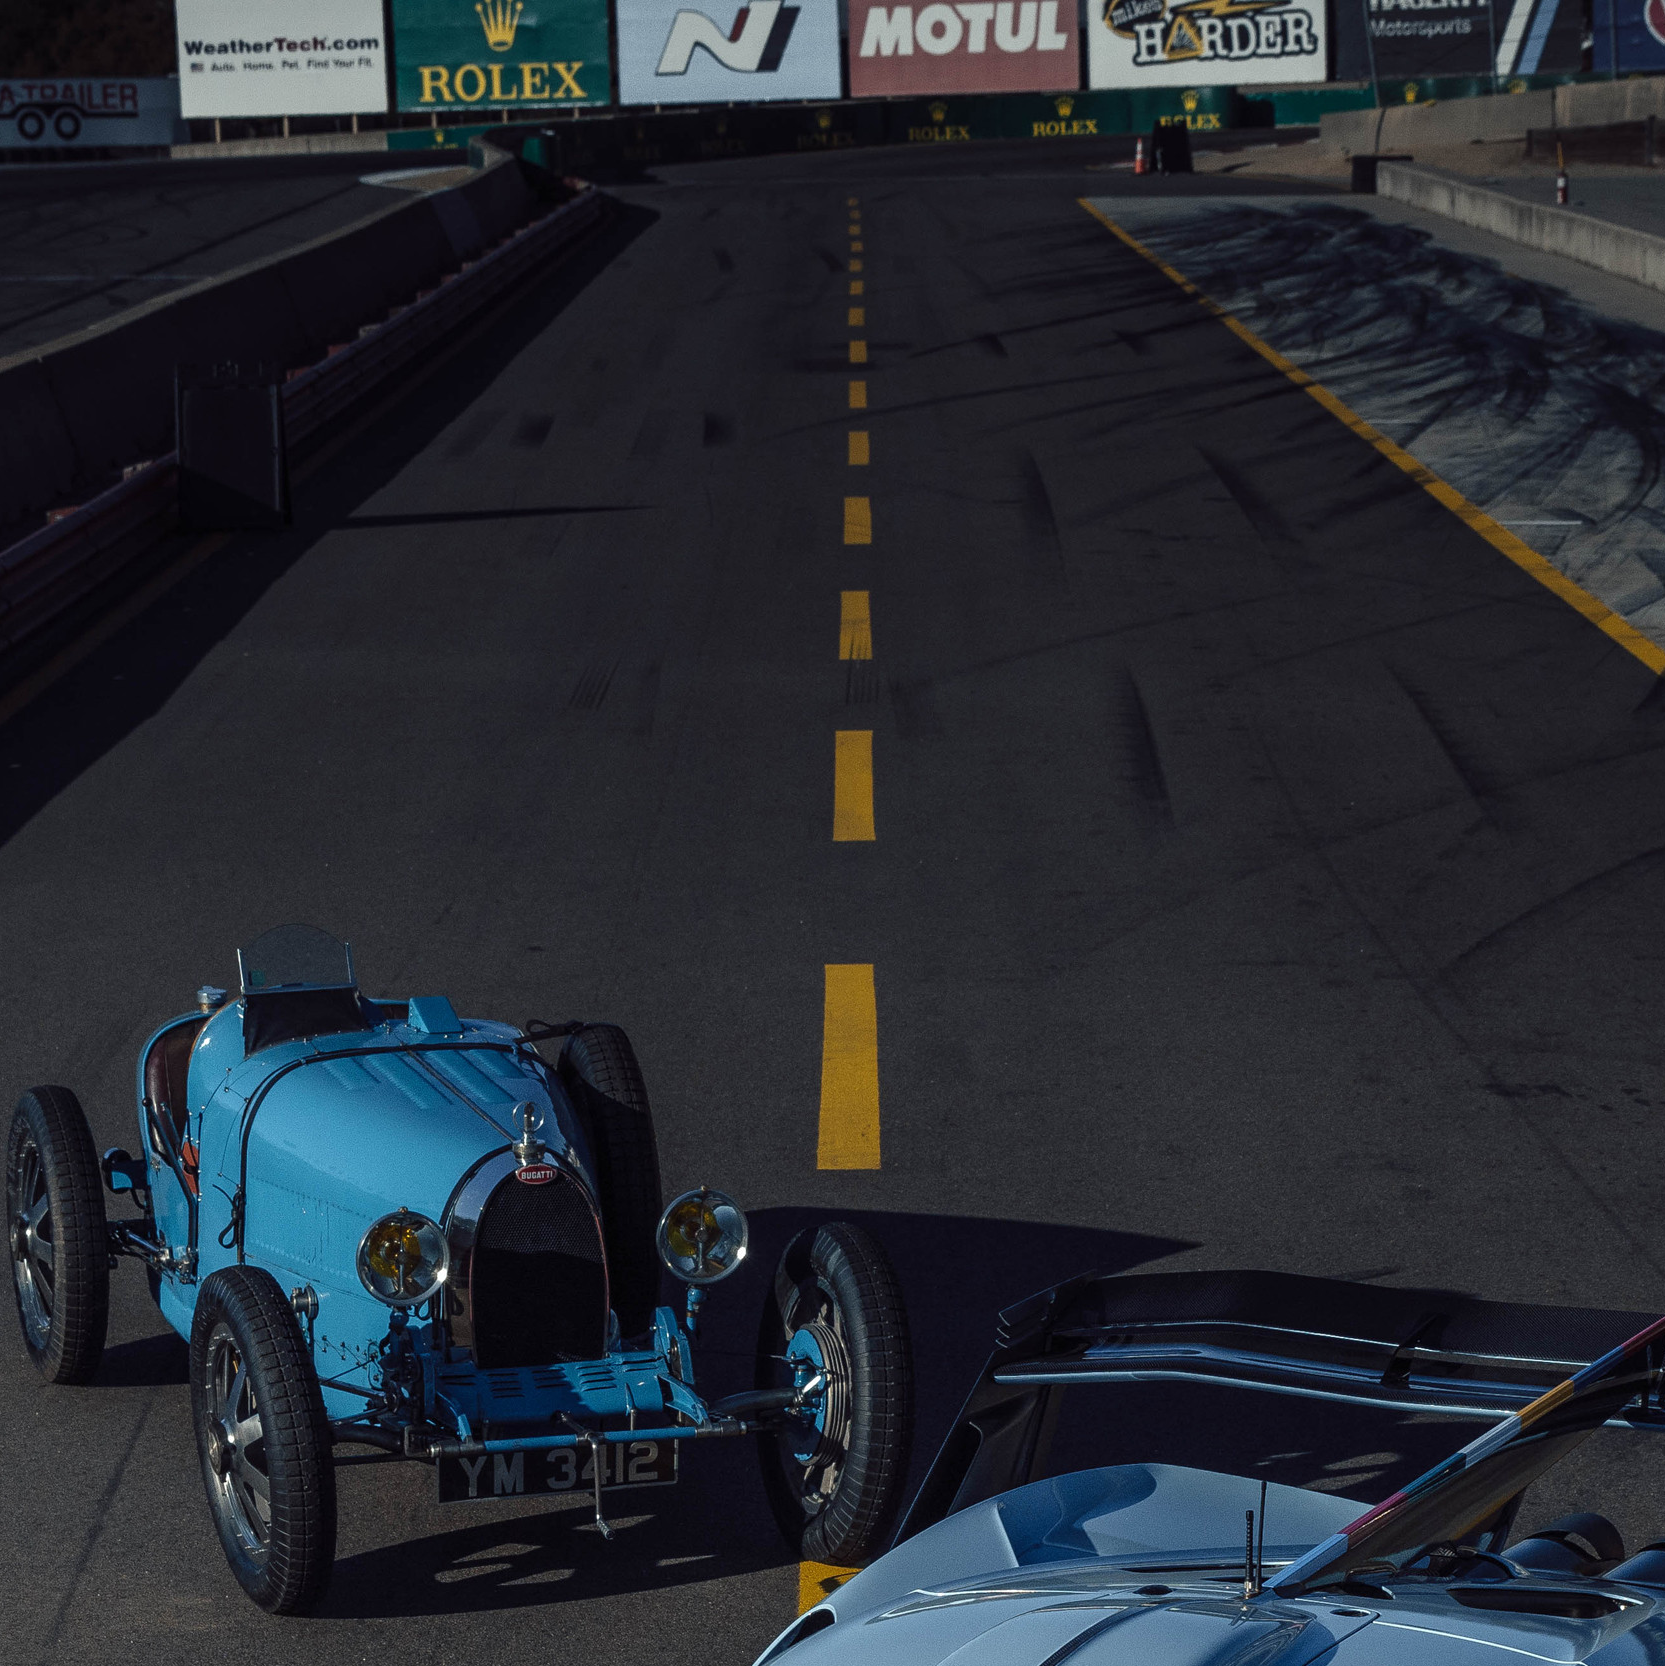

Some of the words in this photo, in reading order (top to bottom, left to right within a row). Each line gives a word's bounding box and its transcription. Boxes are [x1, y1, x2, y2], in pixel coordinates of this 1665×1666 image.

[859, 1, 1069, 58] MOTUL
[1369, 17, 1472, 39] Motorsports
[418, 61, 588, 103] ROLEX
[23, 83, 138, 110] TRAILER
[908, 125, 970, 142] ROLEX
[1033, 119, 1099, 137] ROLEX
[521, 1170, 553, 1180] BUGATTI
[459, 1451, 524, 1497] YM
[546, 1440, 659, 1490] 3412
